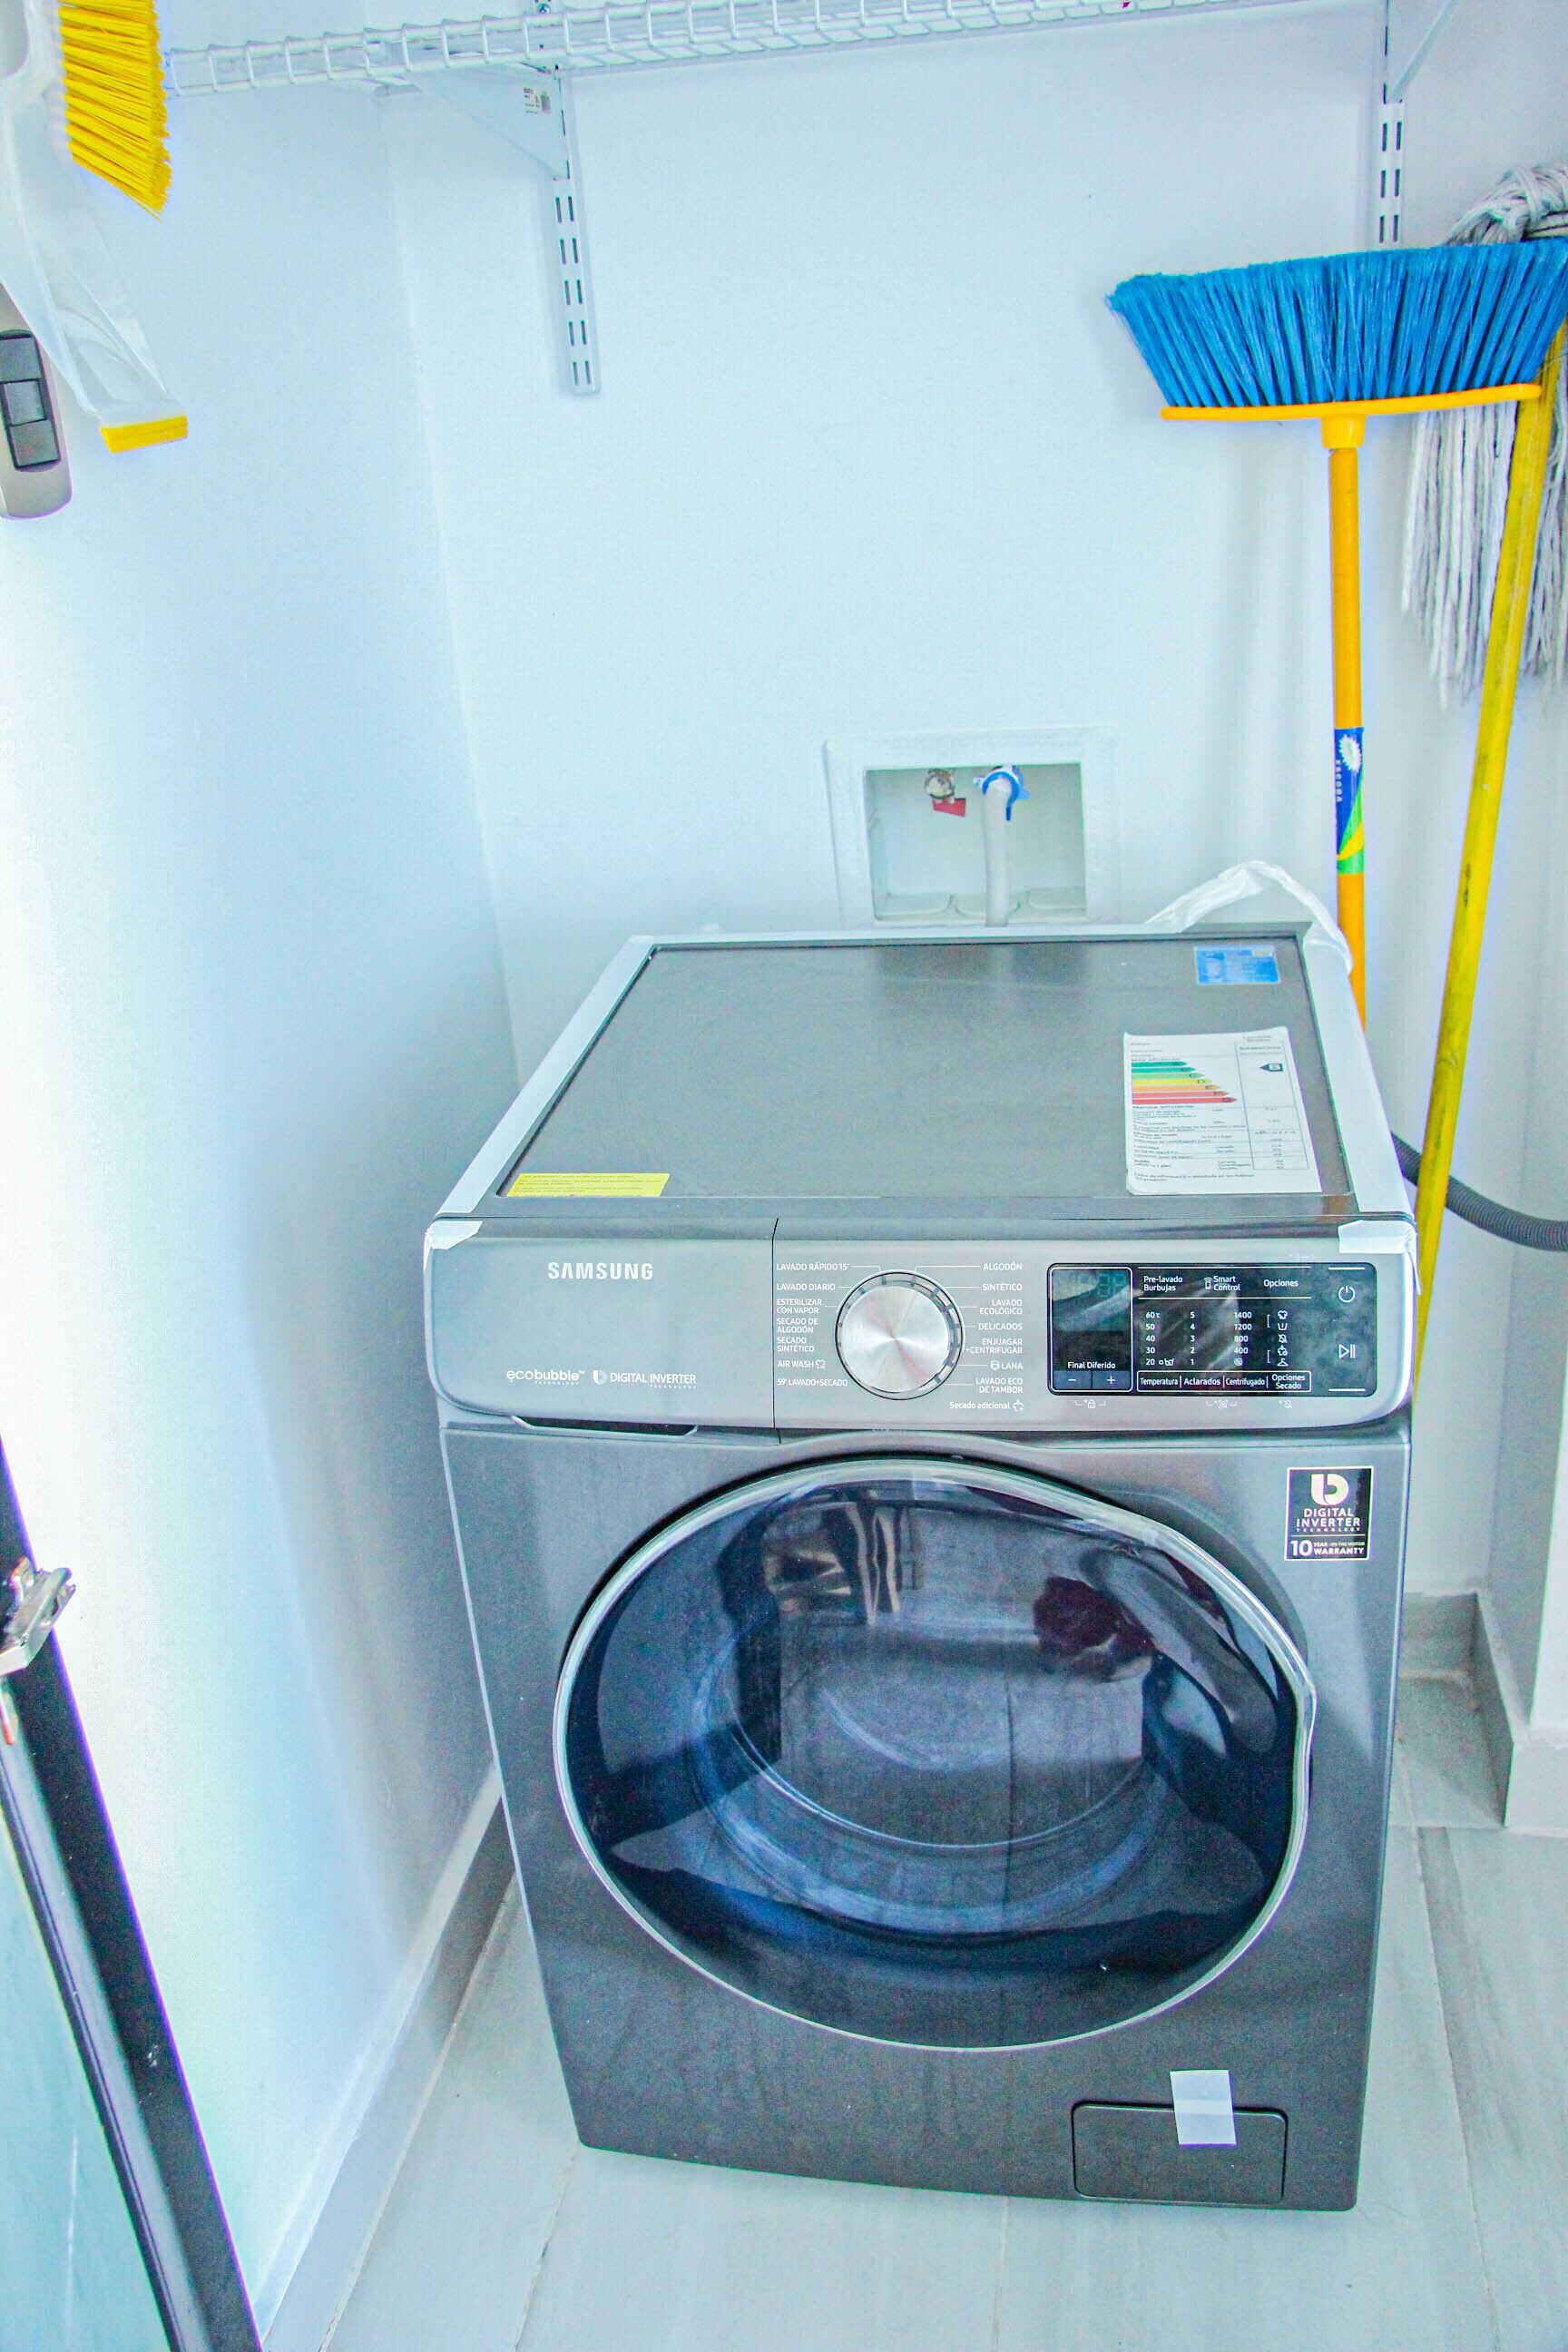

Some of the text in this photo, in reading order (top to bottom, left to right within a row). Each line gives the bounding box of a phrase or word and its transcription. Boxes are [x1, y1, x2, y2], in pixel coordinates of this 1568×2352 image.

[547, 1261, 653, 1280] SAMSUNG
[808, 1261, 838, 1271] RÁPIDO
[983, 1261, 1023, 1271] ALGODÓN
[1143, 1275, 1183, 1283] Pre-lavado
[1213, 1275, 1237, 1283] Smart
[1263, 1279, 1299, 1288] Opciones
[808, 1283, 836, 1291] DIARIO
[982, 1282, 1023, 1291] SINTÉTICO
[1143, 1284, 1177, 1293] Burbujas
[992, 1298, 1023, 1307] LAVADO
[979, 1307, 1023, 1315] ECOLÓGICO
[777, 1325, 814, 1333] ALGODÓN
[978, 1322, 1023, 1330] DELICADOS
[982, 1338, 1023, 1346] ENJUAGAR
[777, 1344, 815, 1352] SINTÉTICO
[1067, 1361, 1116, 1369] Final Diferido
[610, 1372, 697, 1384] DIGITAL INVERTER
[1140, 1377, 1179, 1387] Temperatura
[1183, 1377, 1221, 1386] Aclarados
[1225, 1377, 1265, 1387] Centrifugado
[1271, 1373, 1306, 1382] Opciones
[979, 1386, 1024, 1394] DE TAMBOR
[949, 1401, 1010, 1409] Secado adicional
[1303, 1507, 1355, 1518] DIGITAL
[1296, 1517, 1361, 1527] INVERTER
[1289, 1540, 1313, 1556] 10
[1313, 1547, 1365, 1555] WARRANTY
